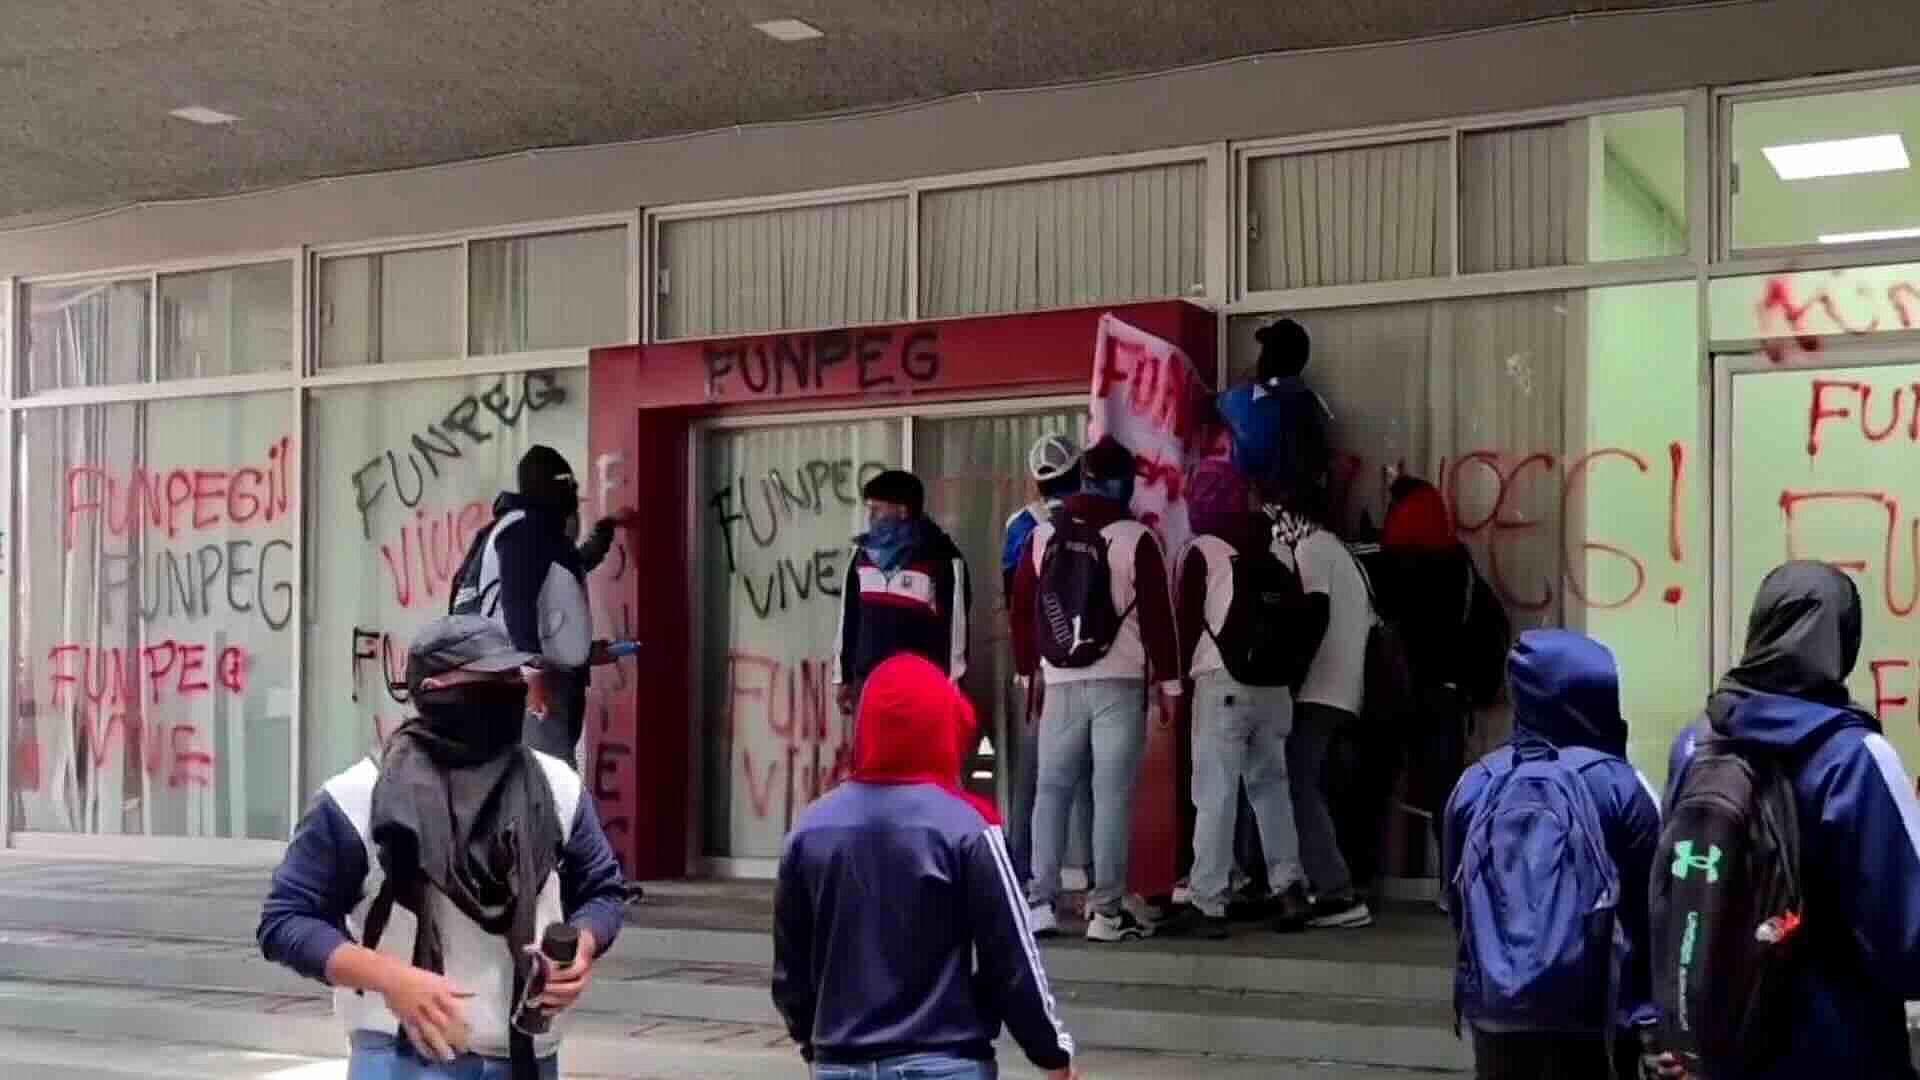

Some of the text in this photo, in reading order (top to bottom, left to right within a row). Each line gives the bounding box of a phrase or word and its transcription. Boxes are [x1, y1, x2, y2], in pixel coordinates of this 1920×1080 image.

[702, 330, 940, 396] FUNPEG
[352, 370, 567, 540] FUNPEG
[1806, 378, 1920, 456] FU
[100, 539, 294, 631] FUNPEG
[743, 550, 843, 619] VIVE
